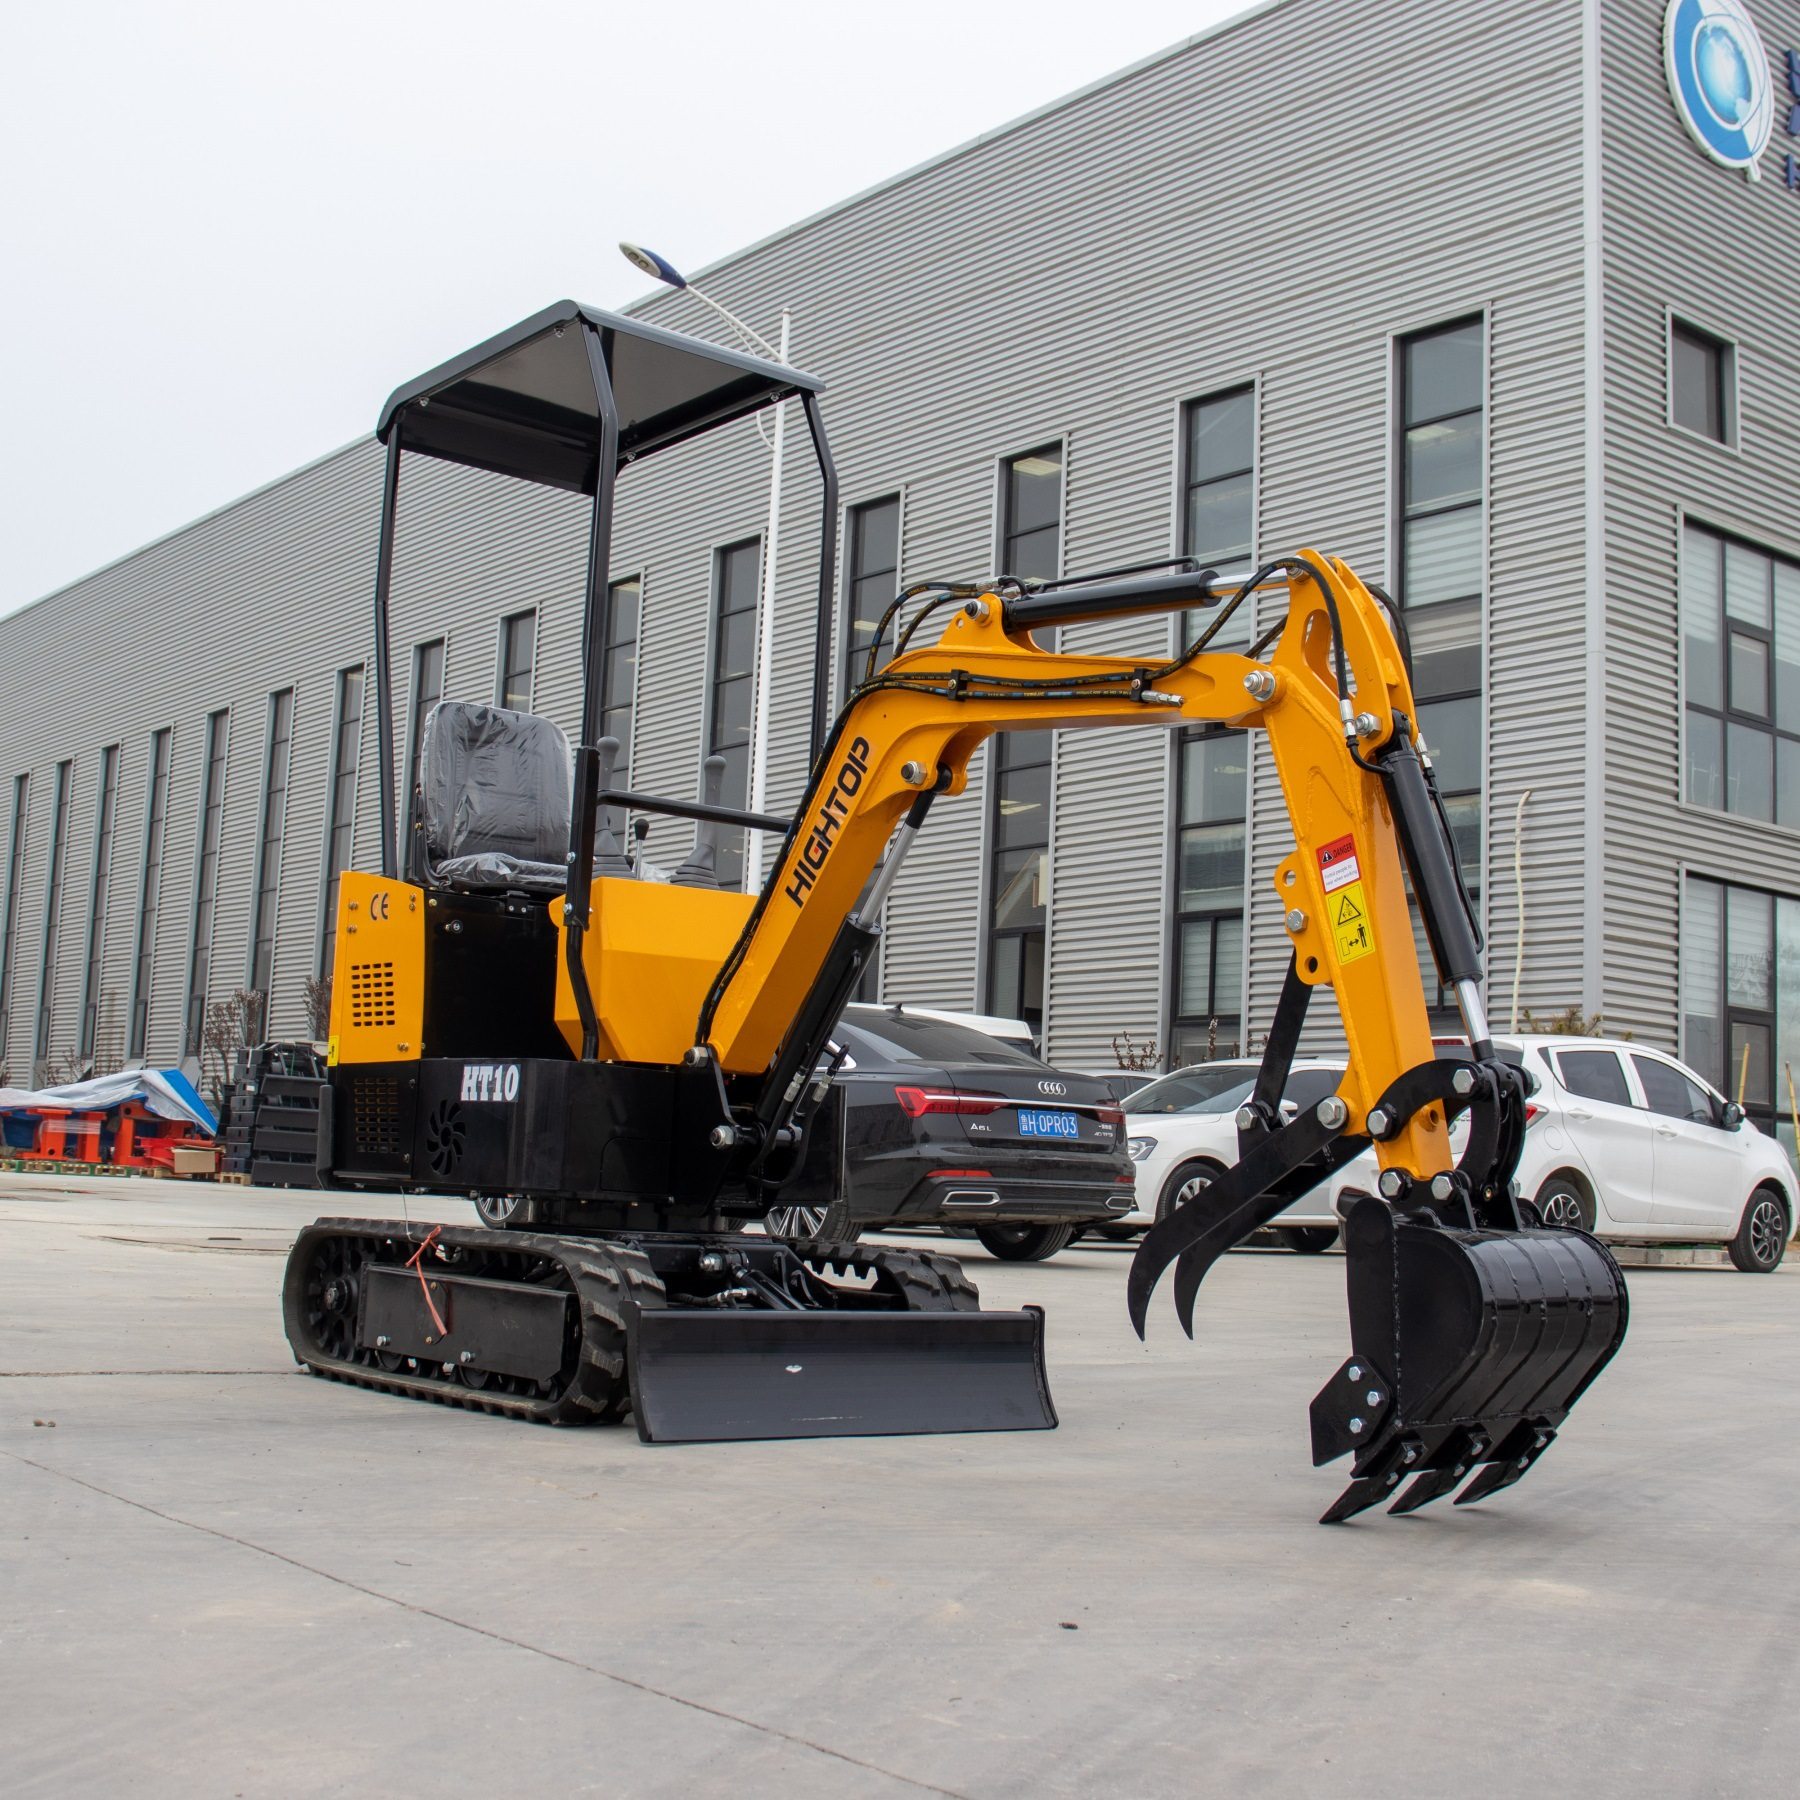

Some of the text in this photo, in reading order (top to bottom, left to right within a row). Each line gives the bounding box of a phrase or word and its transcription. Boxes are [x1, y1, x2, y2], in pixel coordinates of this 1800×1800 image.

[785, 736, 870, 909] HIGHTOP
[1333, 843, 1353, 858] DANGER
[370, 892, 389, 920] CE
[461, 1065, 520, 1101] HT10
